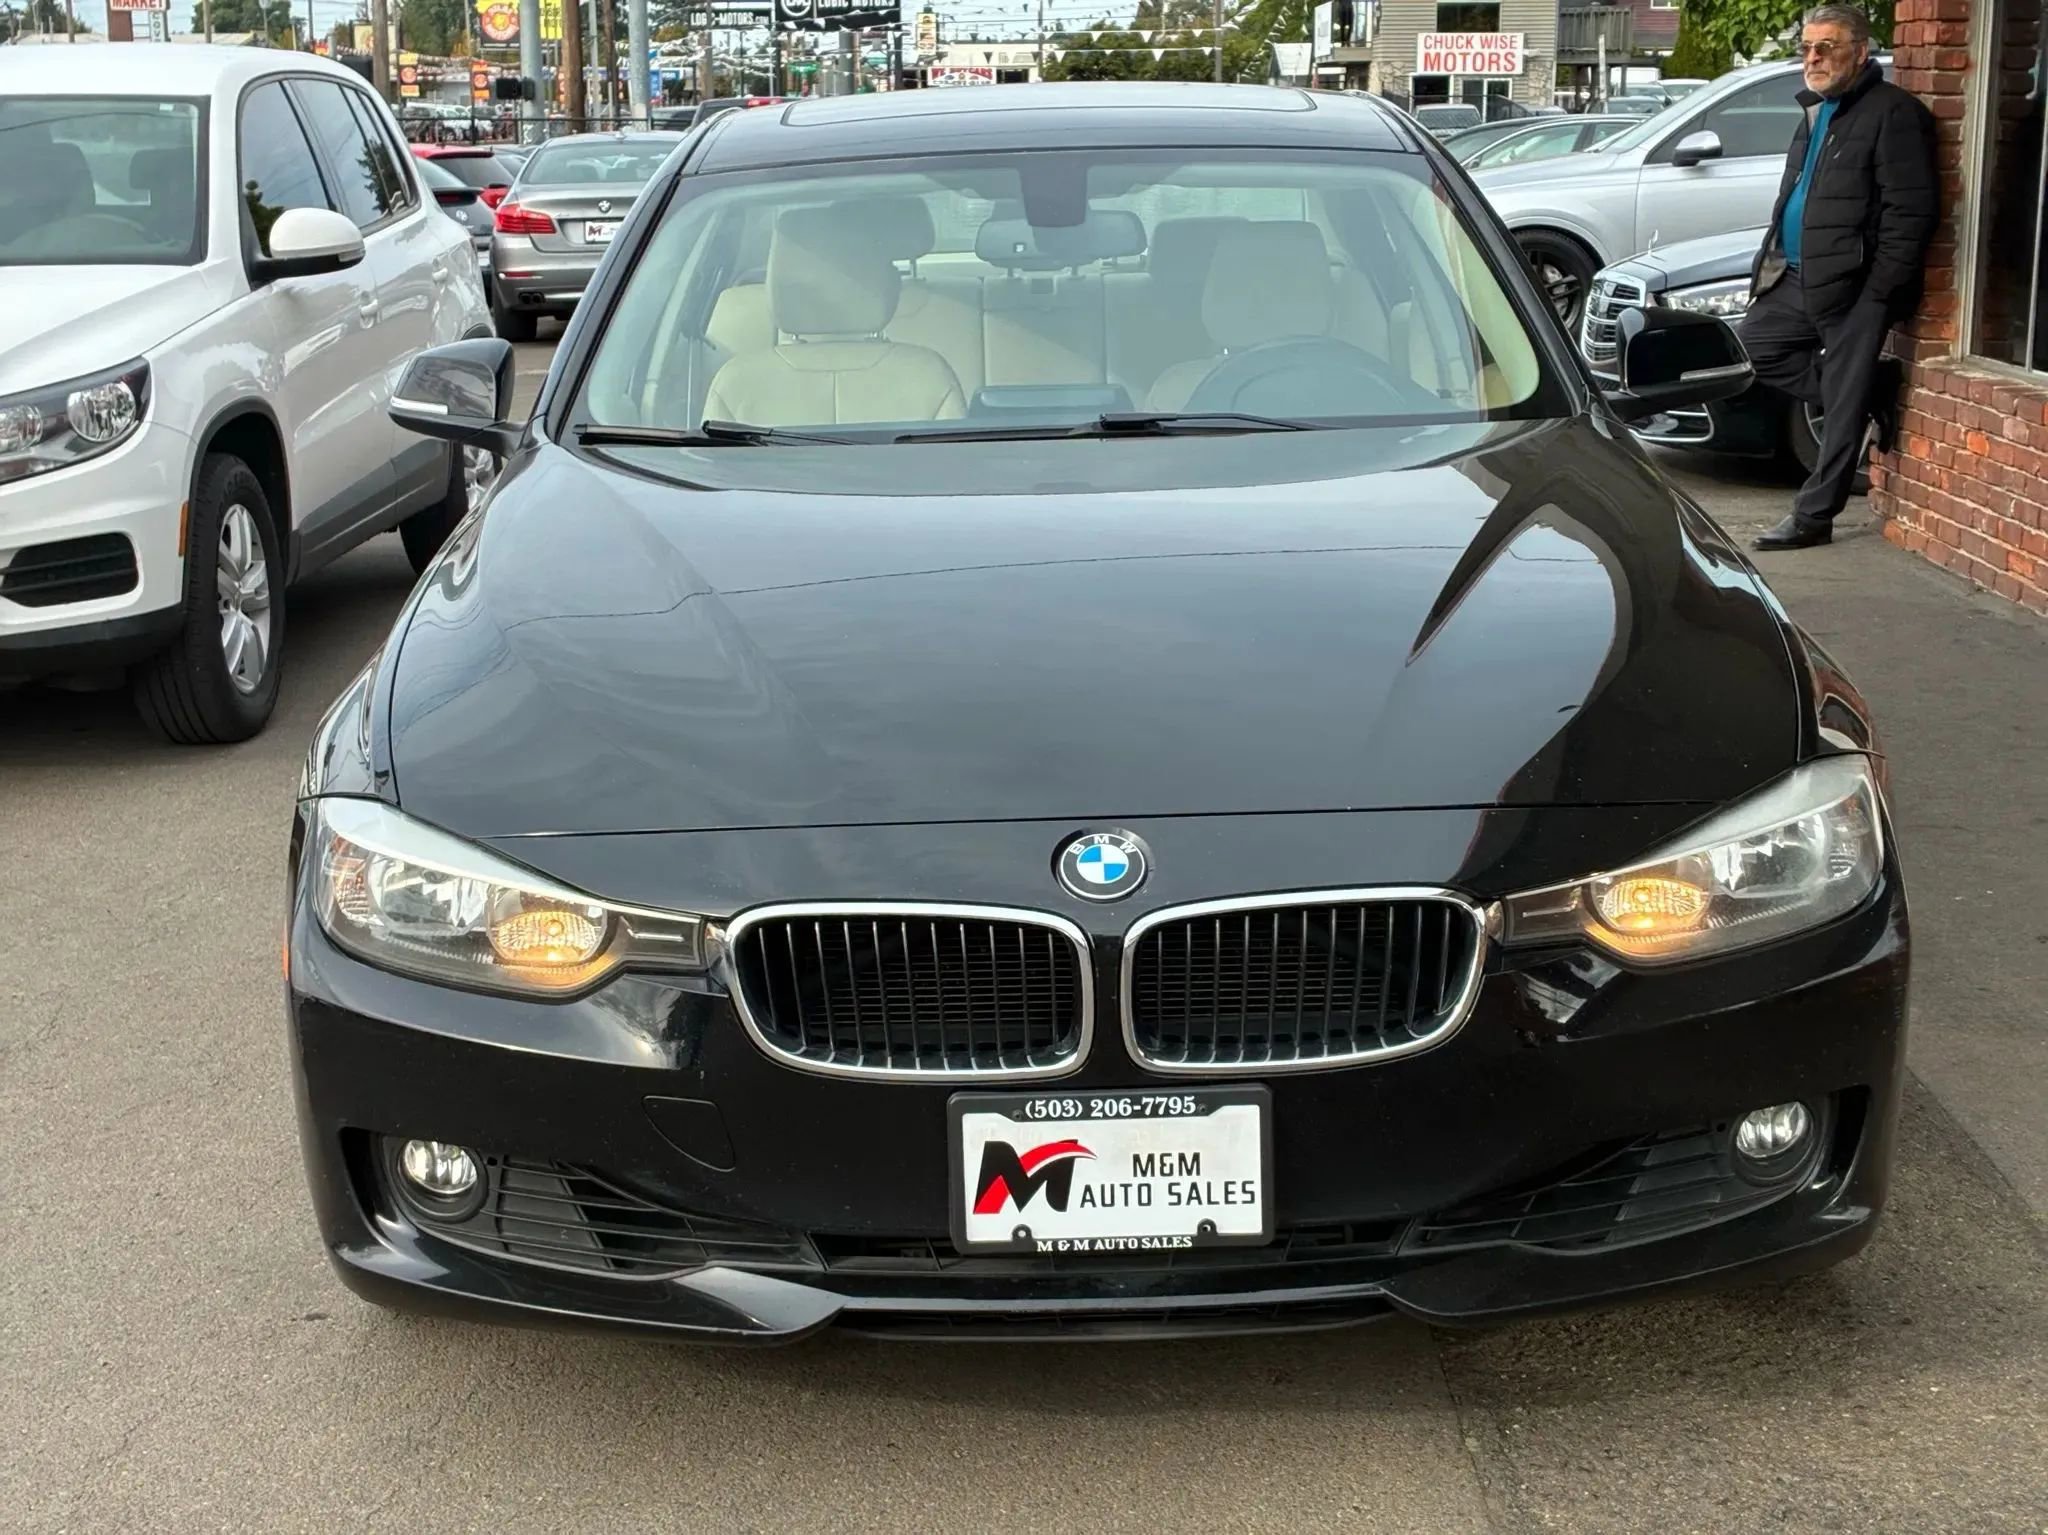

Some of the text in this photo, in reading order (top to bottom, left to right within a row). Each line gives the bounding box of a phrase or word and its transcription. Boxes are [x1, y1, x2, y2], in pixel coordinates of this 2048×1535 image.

[1423, 35, 1518, 49] CHUCK WISE
[1423, 51, 1517, 72] MOTORS
[1068, 835, 1137, 855] BMW
[1024, 1096, 1197, 1119] (503) 206-7795
[1132, 1152, 1202, 1178] M&M
[1080, 1180, 1256, 1209] AUTO SALES
[1037, 1239, 1053, 1252] M
[1073, 1238, 1091, 1251] M
[1094, 1237, 1139, 1250] AUTO
[1141, 1236, 1193, 1249] SALES
